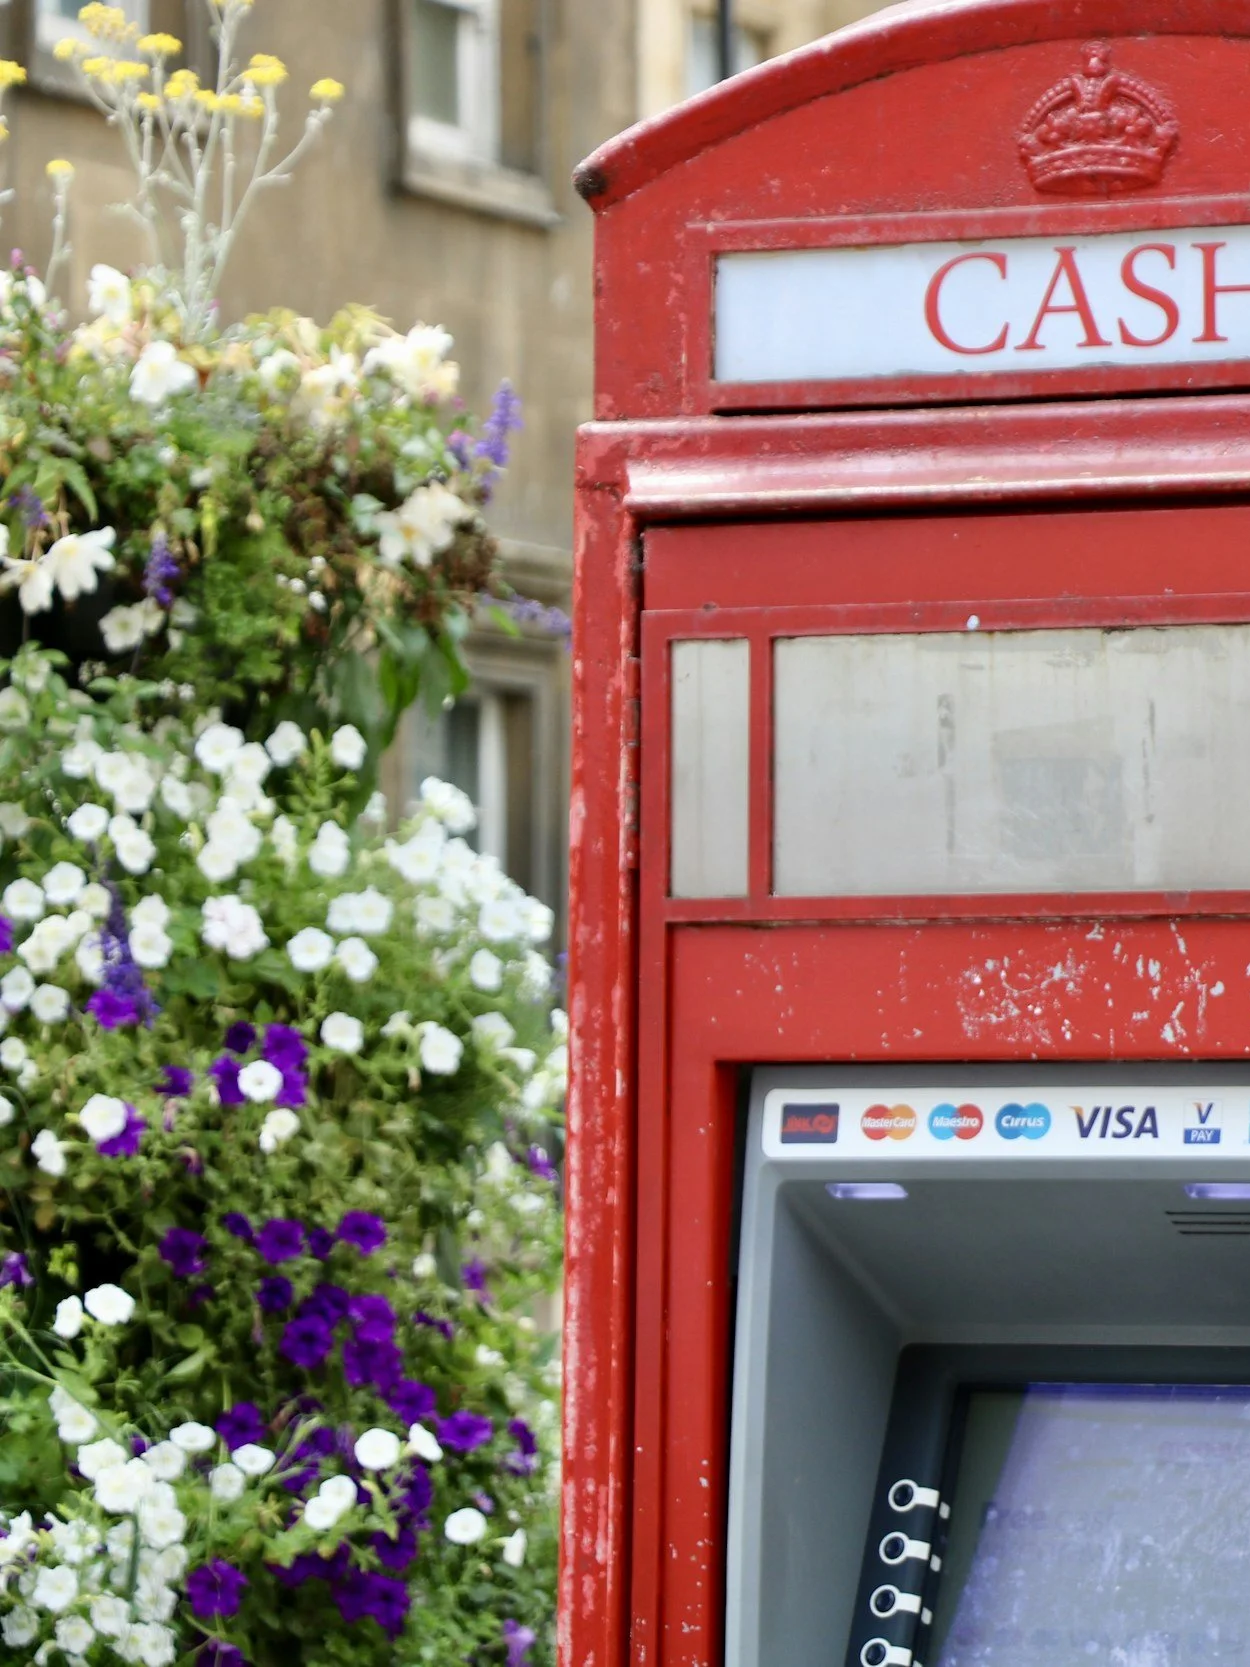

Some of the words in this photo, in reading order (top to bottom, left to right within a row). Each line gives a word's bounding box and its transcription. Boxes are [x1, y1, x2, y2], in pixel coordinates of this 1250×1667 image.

[1001, 1113, 1045, 1128] Cirrus
[1192, 1102, 1215, 1125] V
[860, 1115, 917, 1129] MasterCard
[932, 1114, 980, 1128] Maestro
[1068, 1105, 1160, 1139] VISA
[1189, 1129, 1214, 1142] PAY
